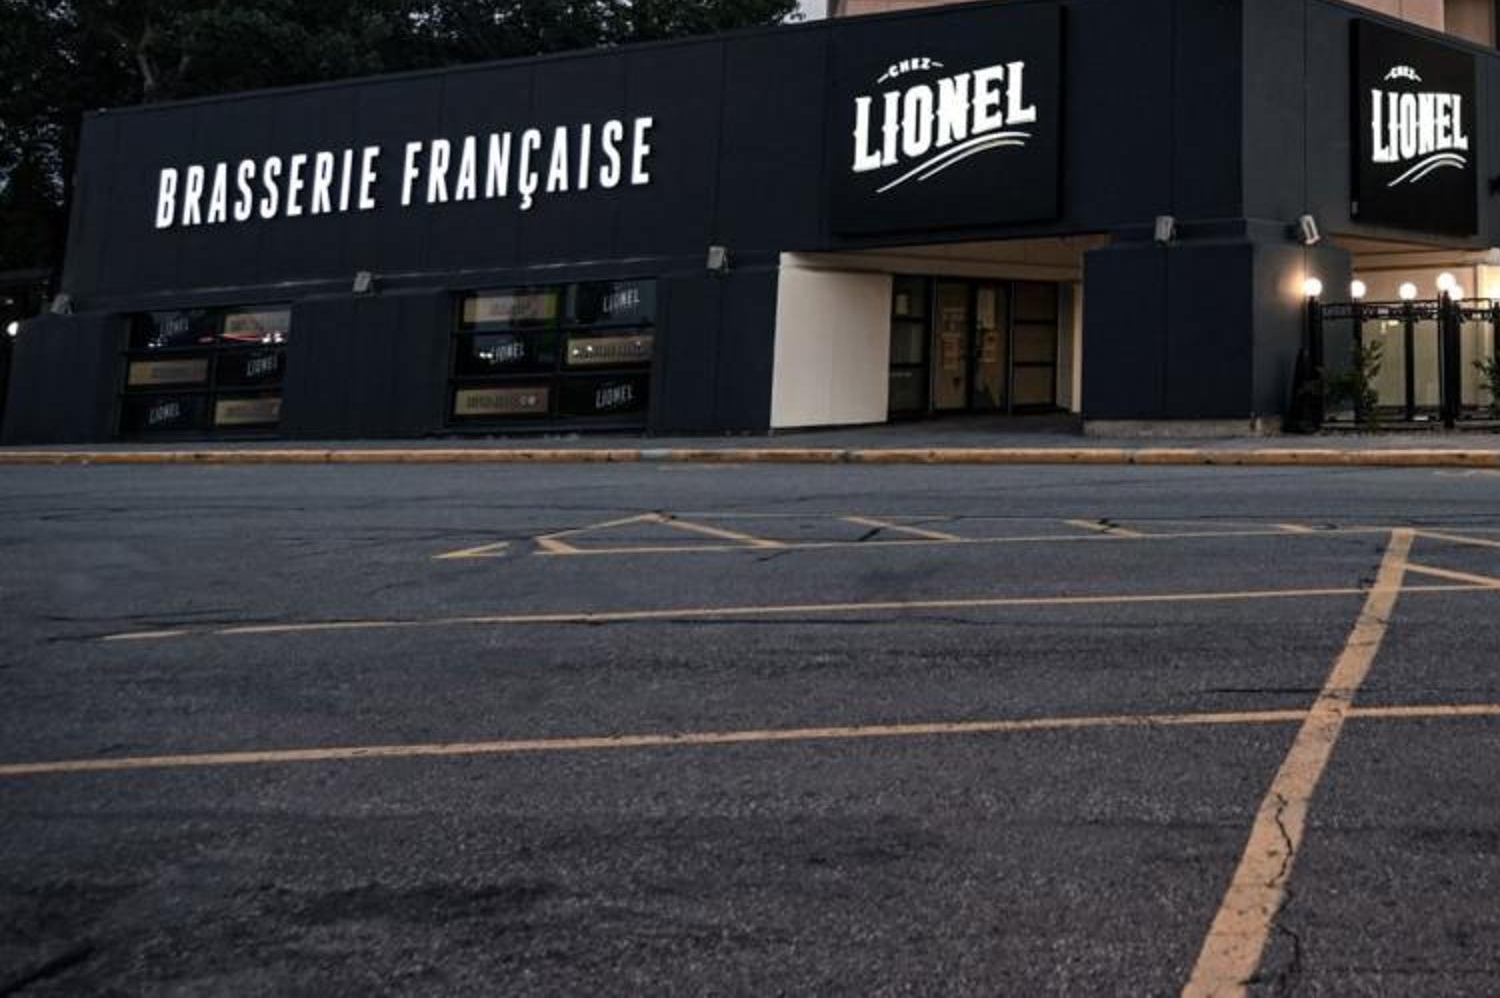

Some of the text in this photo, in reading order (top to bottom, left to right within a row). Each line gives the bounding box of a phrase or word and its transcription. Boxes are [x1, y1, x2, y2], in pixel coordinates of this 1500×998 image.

[888, 58, 931, 78] CHEZ
[853, 62, 1036, 172] LIONEL
[1372, 90, 1468, 163] LIONEL
[156, 117, 653, 229] BRASSERIE FRANÇAISE
